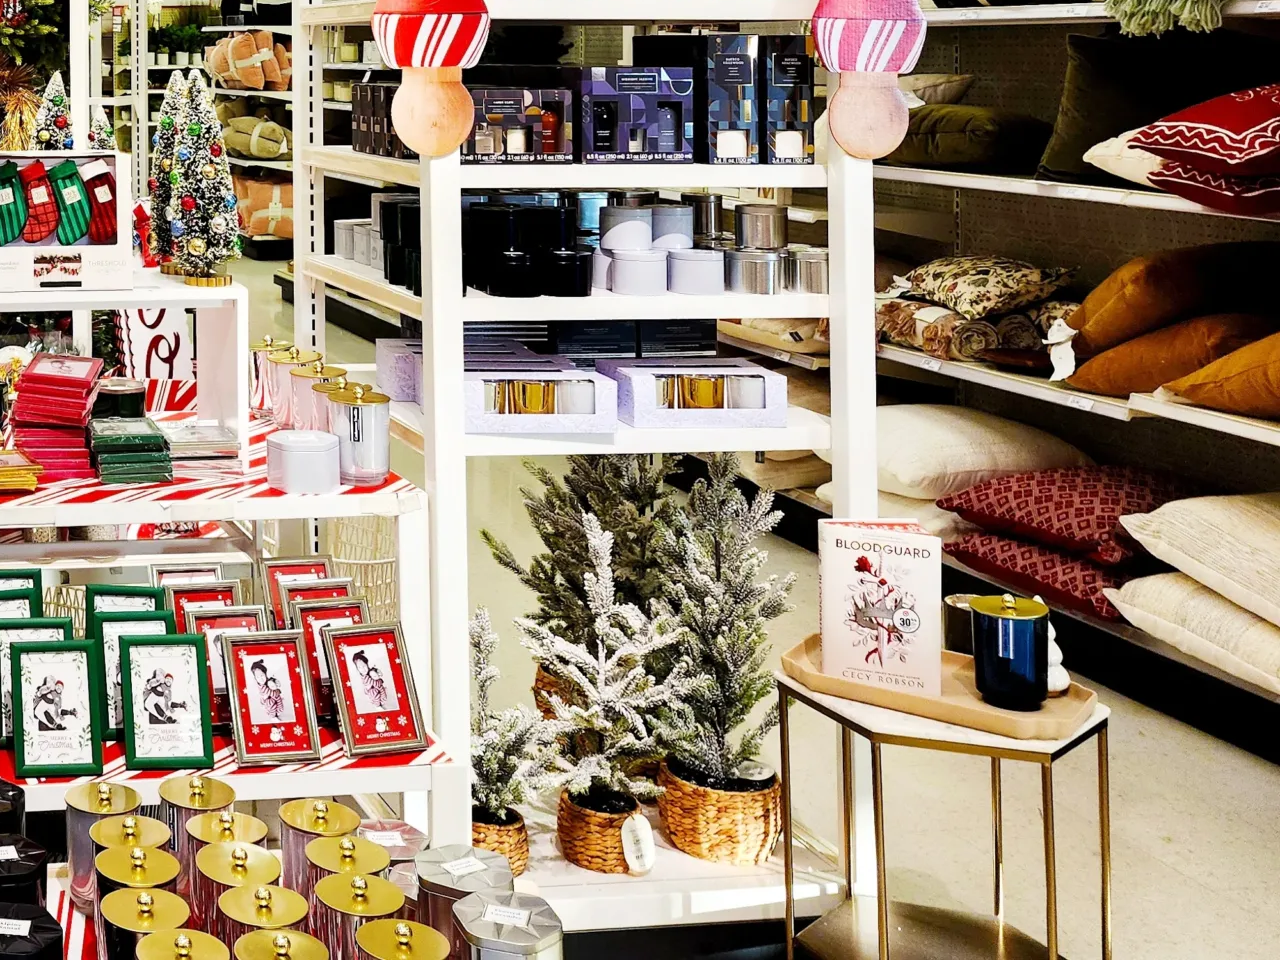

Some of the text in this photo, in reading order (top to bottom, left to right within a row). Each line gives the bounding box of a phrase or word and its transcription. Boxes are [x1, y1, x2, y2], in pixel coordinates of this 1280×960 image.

[835, 538, 931, 559] BLOODGUARD
[900, 617, 911, 627] 30
[842, 670, 925, 689] CECY ROBSON
